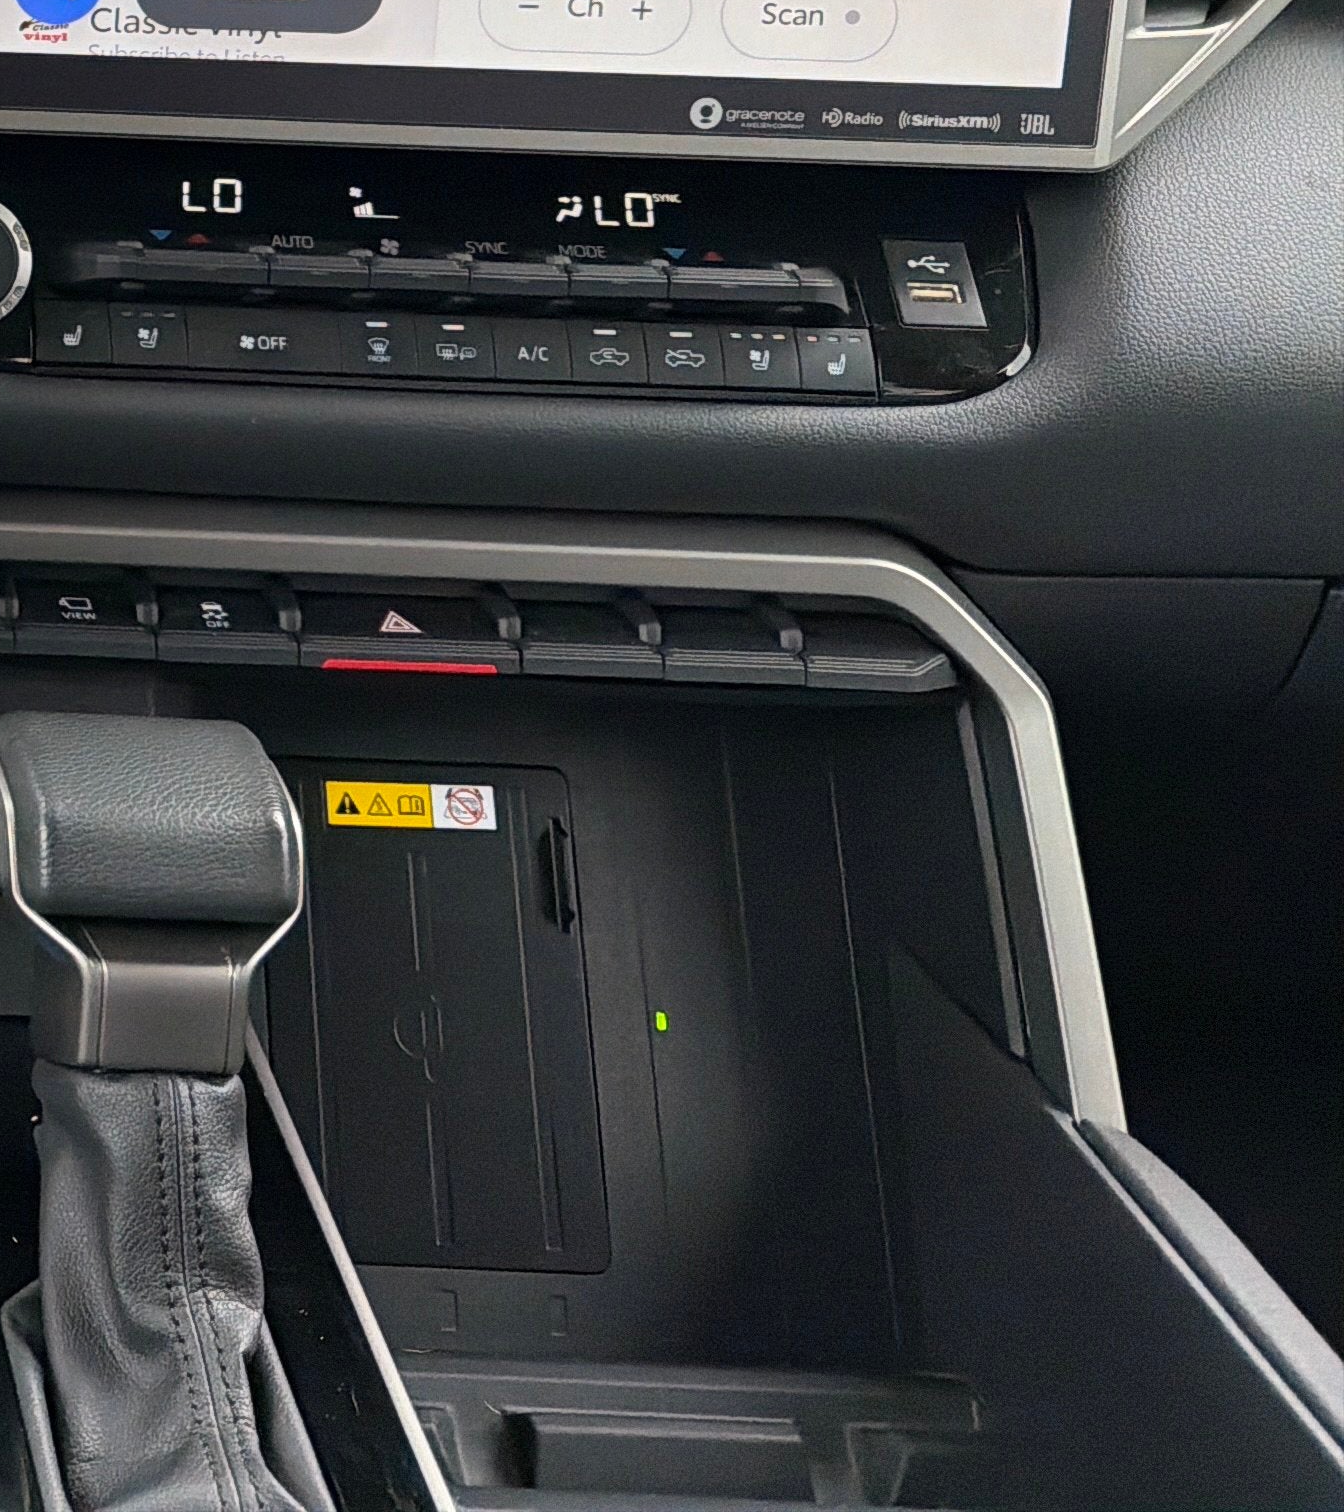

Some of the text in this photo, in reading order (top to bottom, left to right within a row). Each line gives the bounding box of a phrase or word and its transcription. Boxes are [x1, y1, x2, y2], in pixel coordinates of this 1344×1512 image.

[762, 3, 825, 27] Scan
[23, 32, 68, 43] vinyl
[726, 108, 805, 124] gracenote
[844, 111, 884, 126] Radio
[1019, 113, 1055, 136] JBL
[182, 177, 243, 214] LO
[593, 192, 655, 228] LO
[272, 235, 314, 250] AUTO
[465, 241, 509, 255] SYNC
[558, 244, 607, 259] MODE
[258, 336, 287, 350] OFF
[518, 347, 549, 363] A/C
[60, 611, 98, 622] VIEW
[205, 619, 231, 630] OFF
